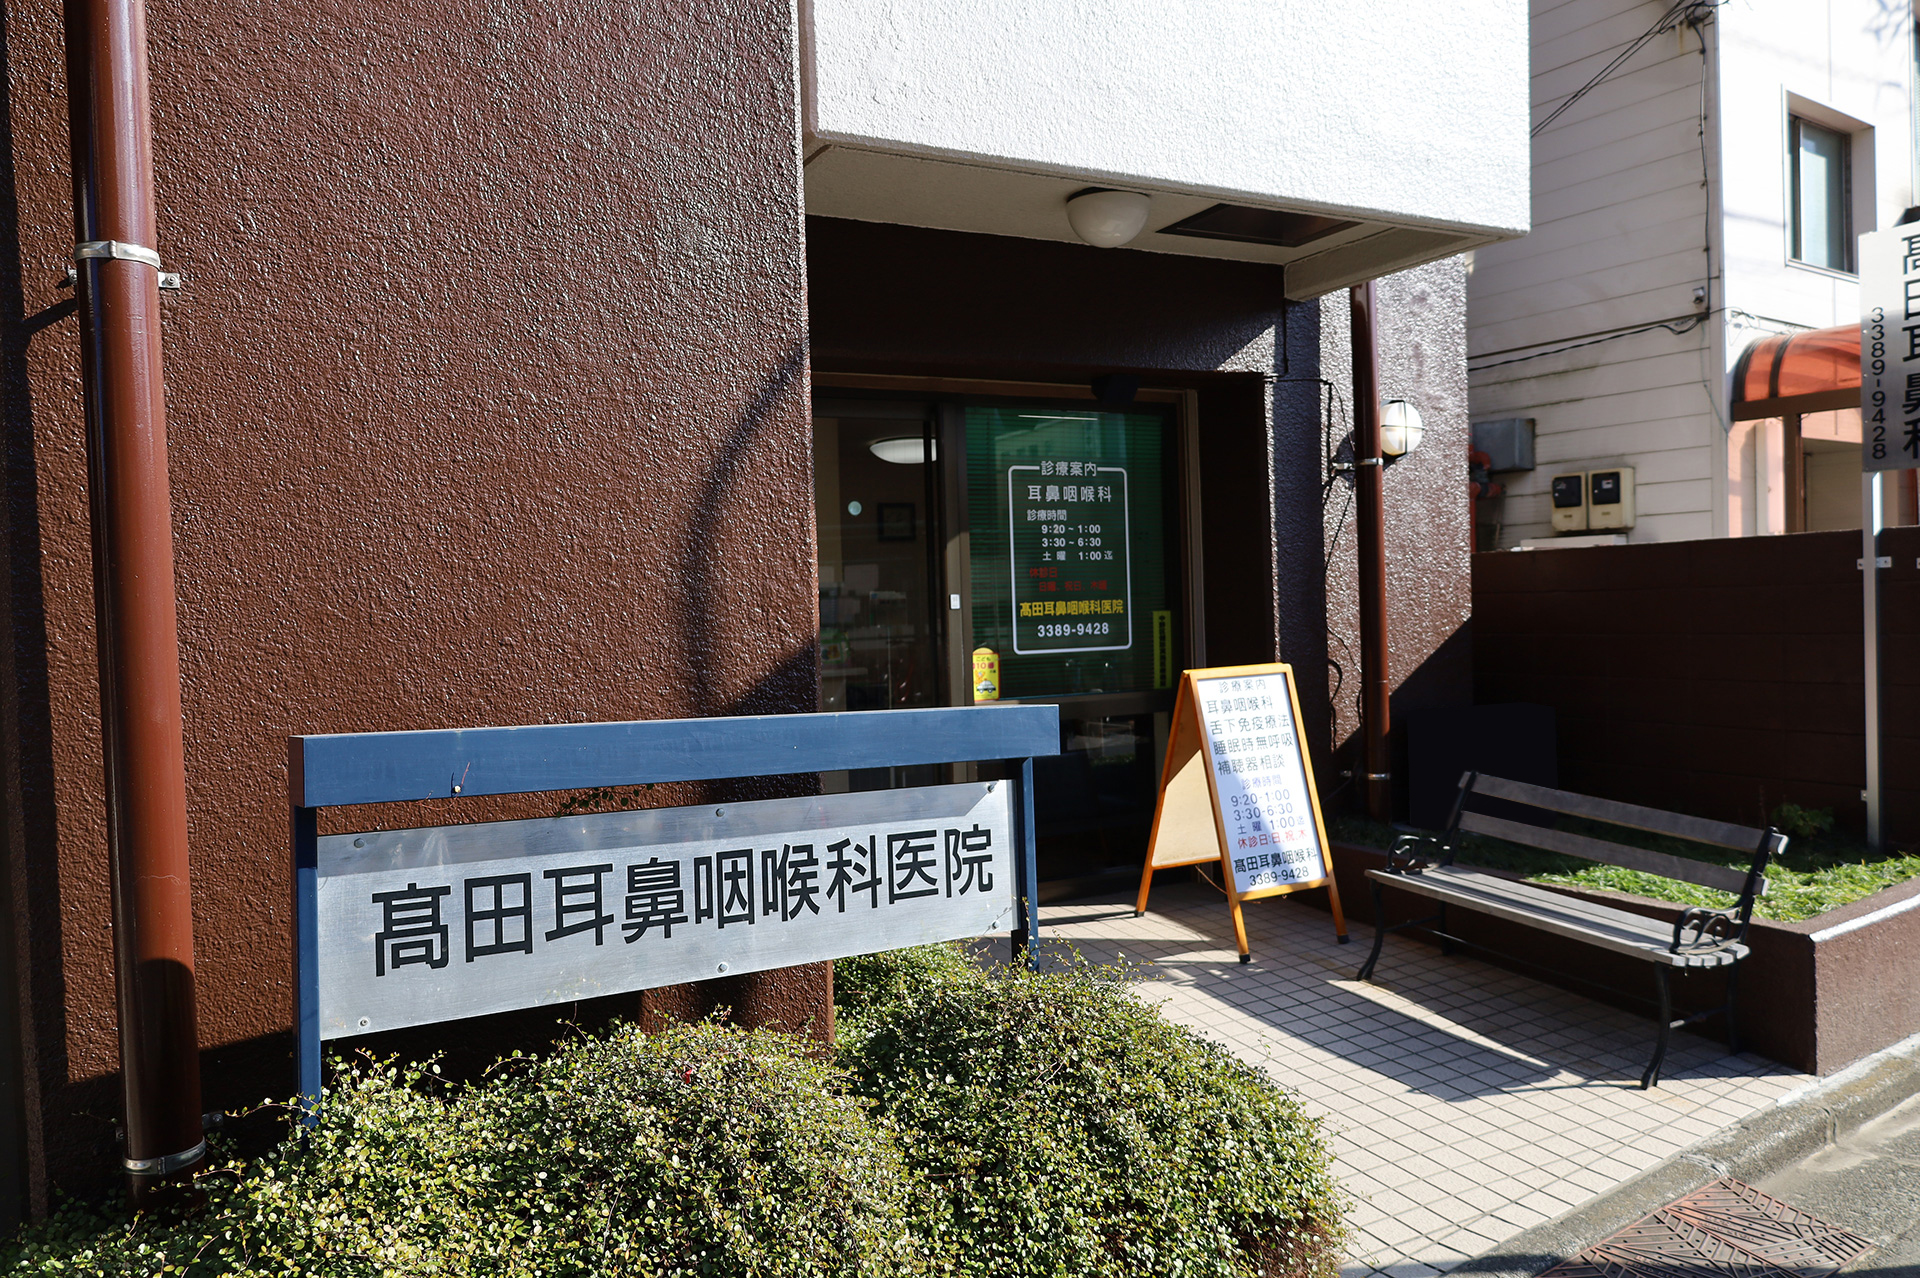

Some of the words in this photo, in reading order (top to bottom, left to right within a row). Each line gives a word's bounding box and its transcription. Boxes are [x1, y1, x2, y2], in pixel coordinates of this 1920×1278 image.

[1871, 306, 1887, 461] 3389-9428
[1041, 460, 1097, 477] 診療案内
[1027, 485, 1112, 502] 耳鼻咽喉科
[1027, 509, 1067, 521] 診療時間
[1037, 622, 1109, 637] 3389-9428
[1219, 679, 1266, 693] 診療案内
[1206, 695, 1273, 714] 耳鼻咽喉科
[1210, 714, 1290, 735] 舌下免疫療法
[1213, 732, 1293, 756] 睡眠時無呼吸
[1217, 754, 1286, 776] 補聴器相談
[1242, 774, 1282, 790] 診療時間
[1249, 866, 1309, 886] 3389-9428
